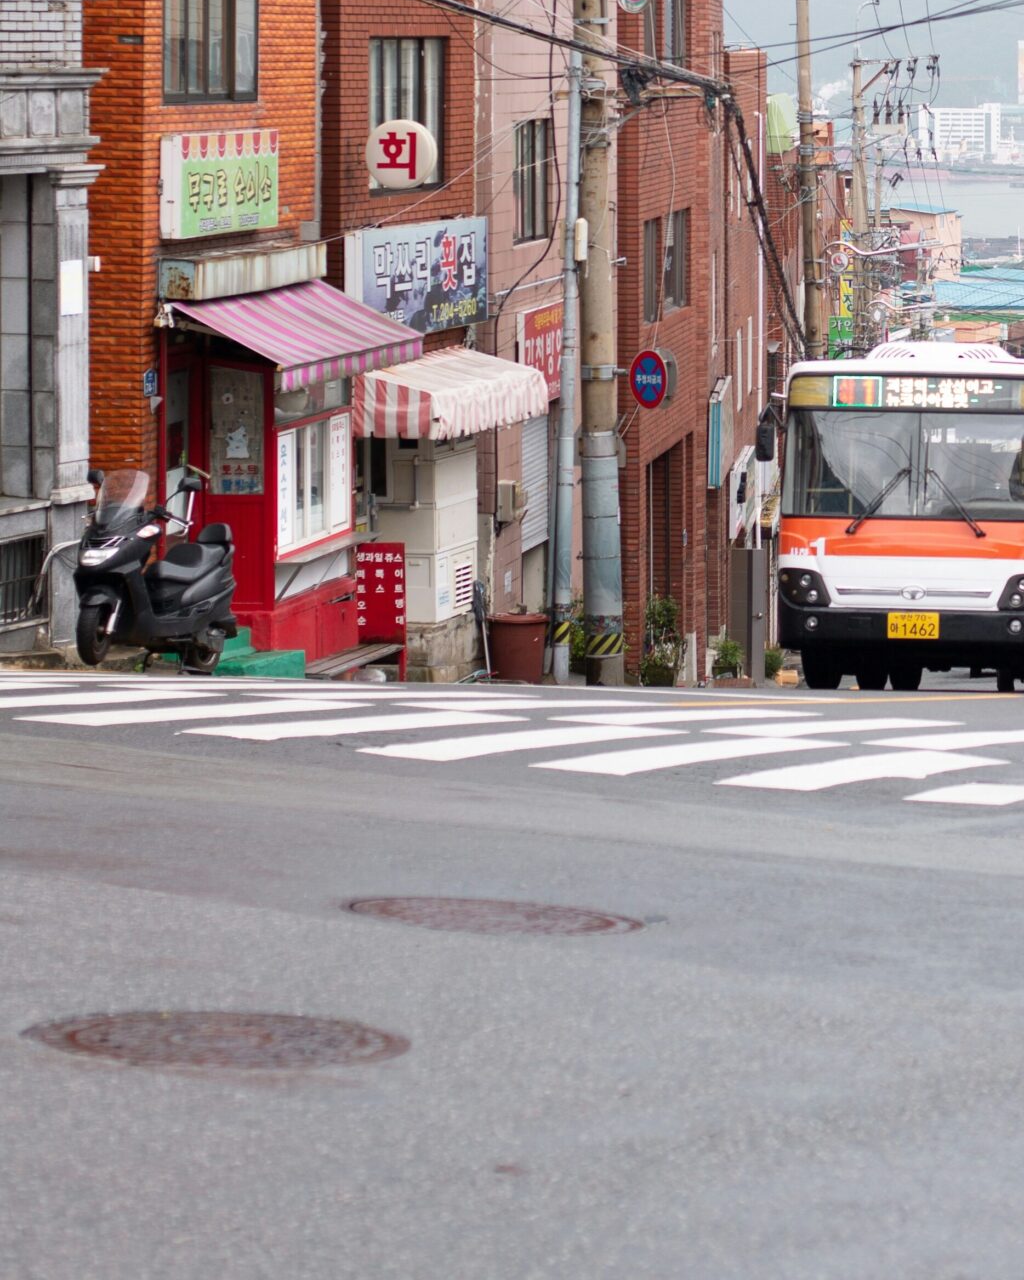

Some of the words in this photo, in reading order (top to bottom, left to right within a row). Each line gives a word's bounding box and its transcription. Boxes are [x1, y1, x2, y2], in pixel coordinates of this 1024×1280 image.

[377, 131, 417, 180] 회
[439, 232, 477, 293] 횟집
[220, 464, 259, 476] 토스트
[900, 614, 913, 622] 부산
[914, 614, 928, 622] 70
